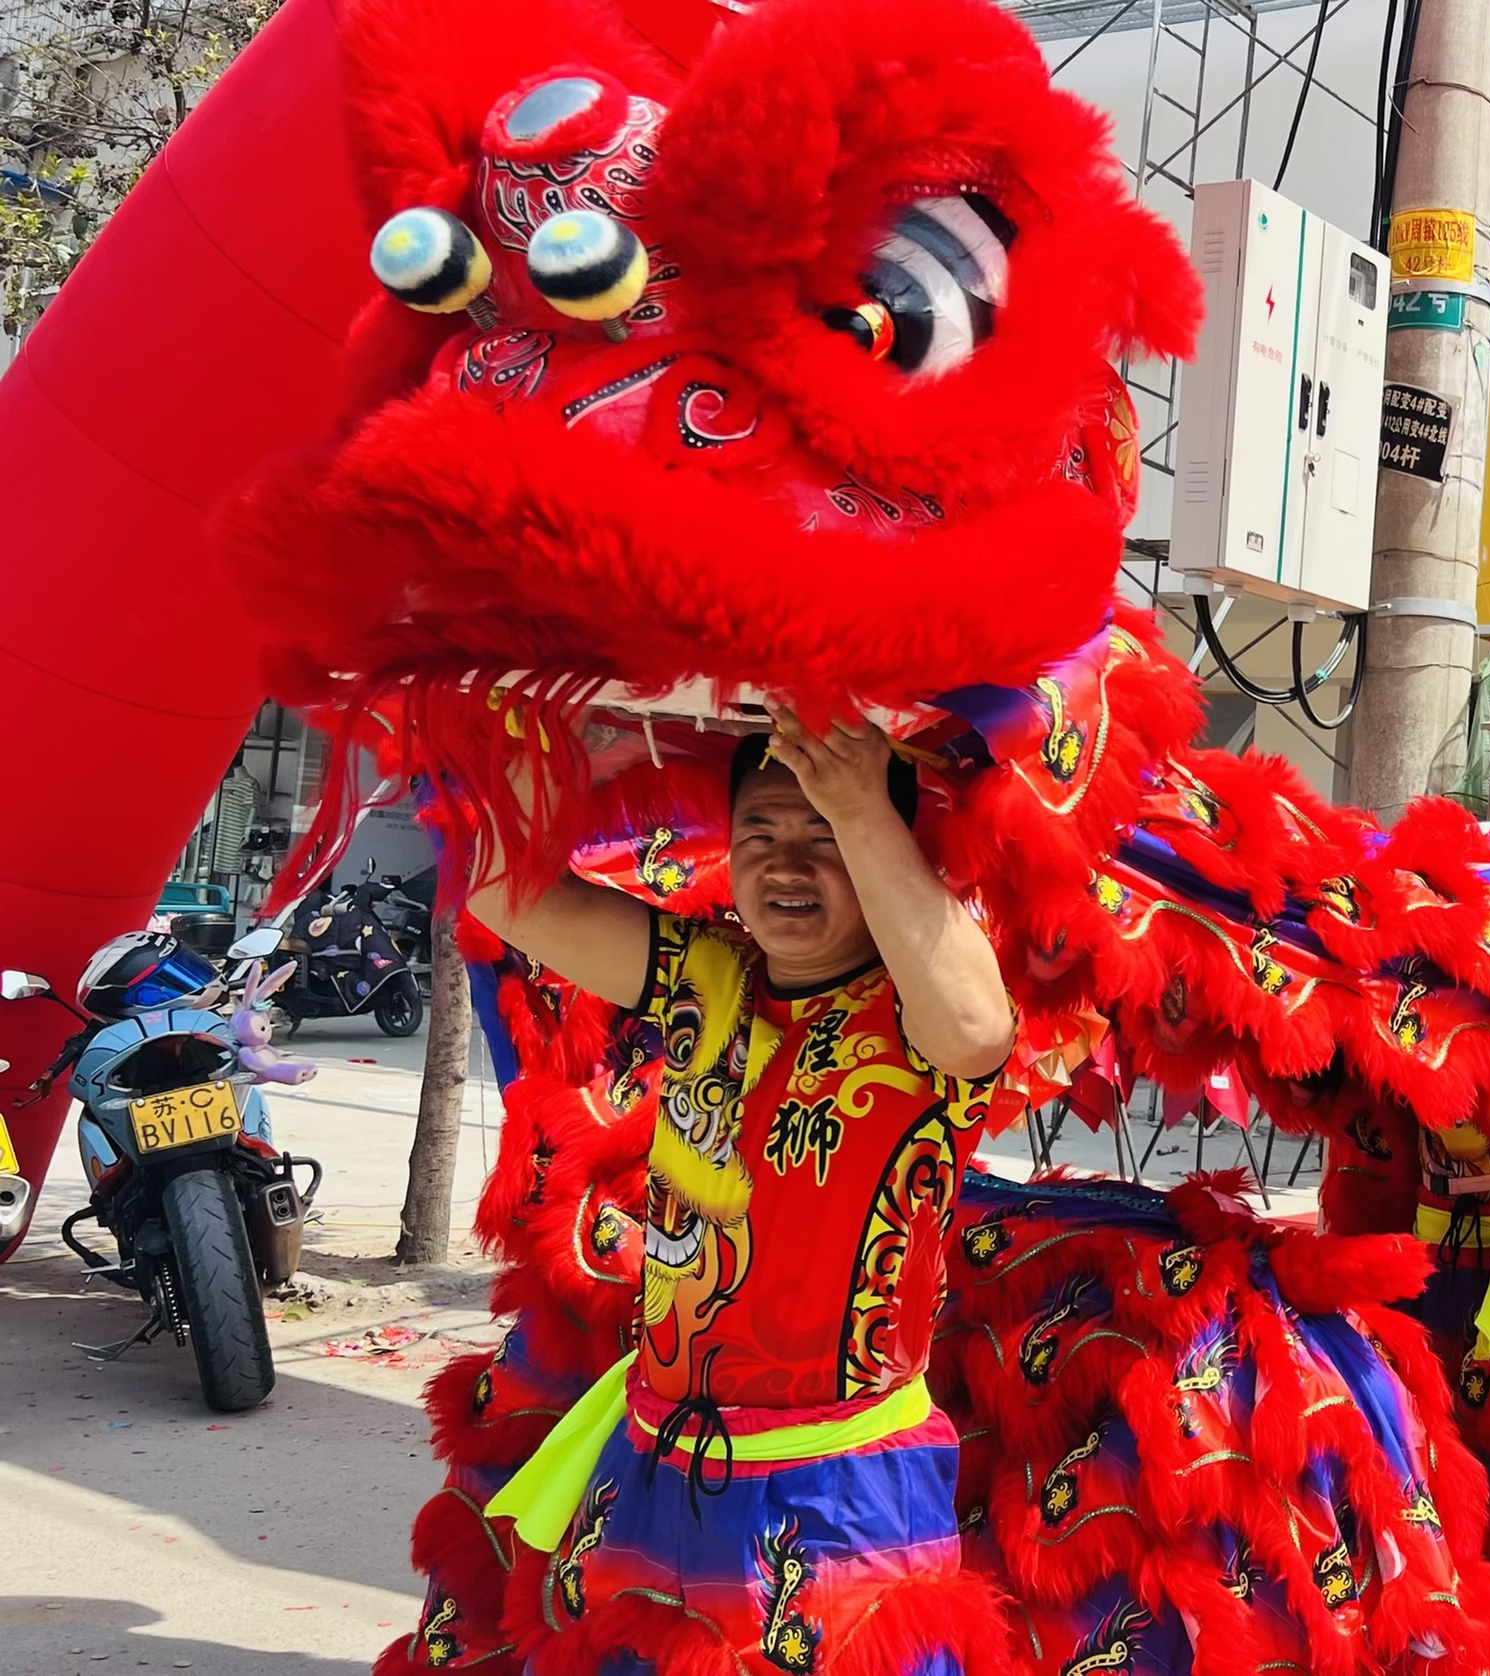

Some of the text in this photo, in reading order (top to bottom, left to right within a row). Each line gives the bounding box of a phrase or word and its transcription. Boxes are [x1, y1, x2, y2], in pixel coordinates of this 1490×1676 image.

[1388, 292, 1450, 314] 42号
[1380, 441, 1421, 470] 04杆
[141, 1107, 236, 1148] BV116
